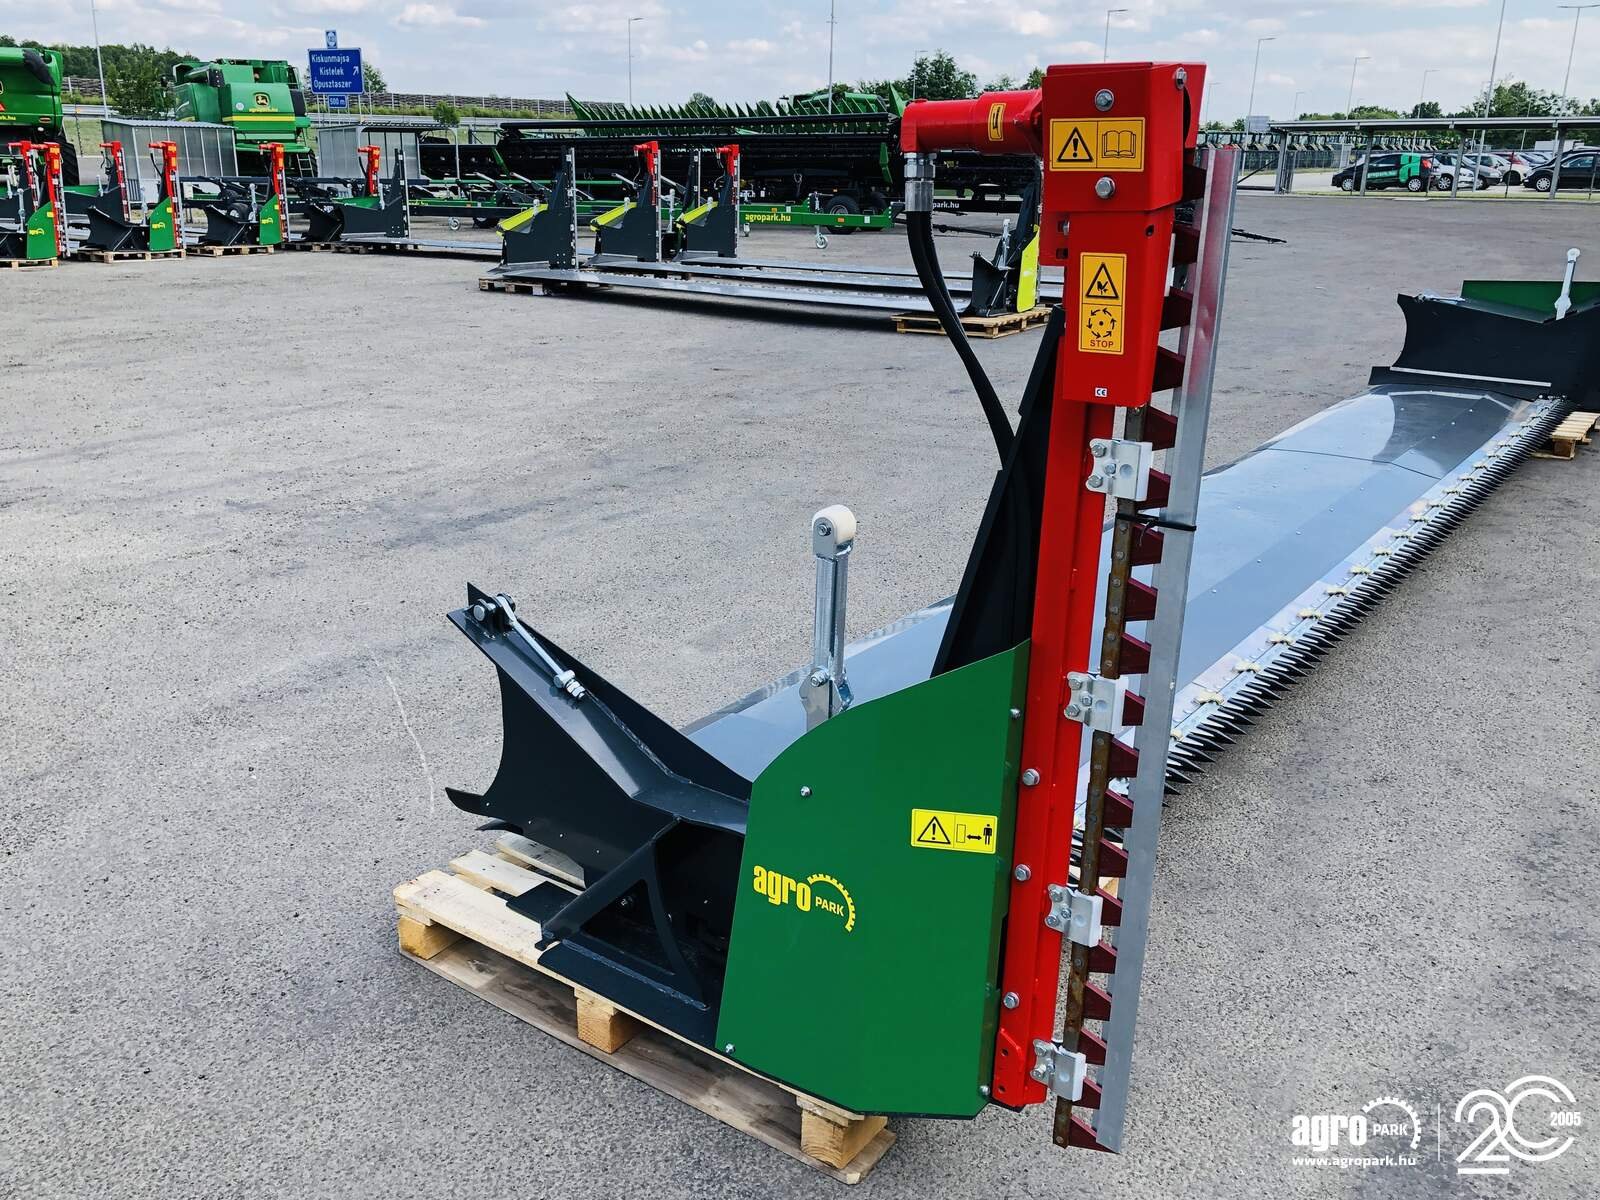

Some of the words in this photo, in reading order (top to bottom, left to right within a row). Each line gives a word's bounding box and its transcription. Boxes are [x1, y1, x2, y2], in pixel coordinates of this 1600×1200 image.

[311, 54, 350, 64] Kiskunmajsa
[319, 67, 344, 76] Kistelek
[313, 77, 352, 89] Ópusztaszer
[932, 201, 960, 209] park.hu
[745, 213, 791, 222] agropark.hu
[1089, 339, 1114, 348] STOP
[1096, 388, 1107, 396] CE
[753, 865, 811, 912] agro
[815, 896, 844, 917] PARK
